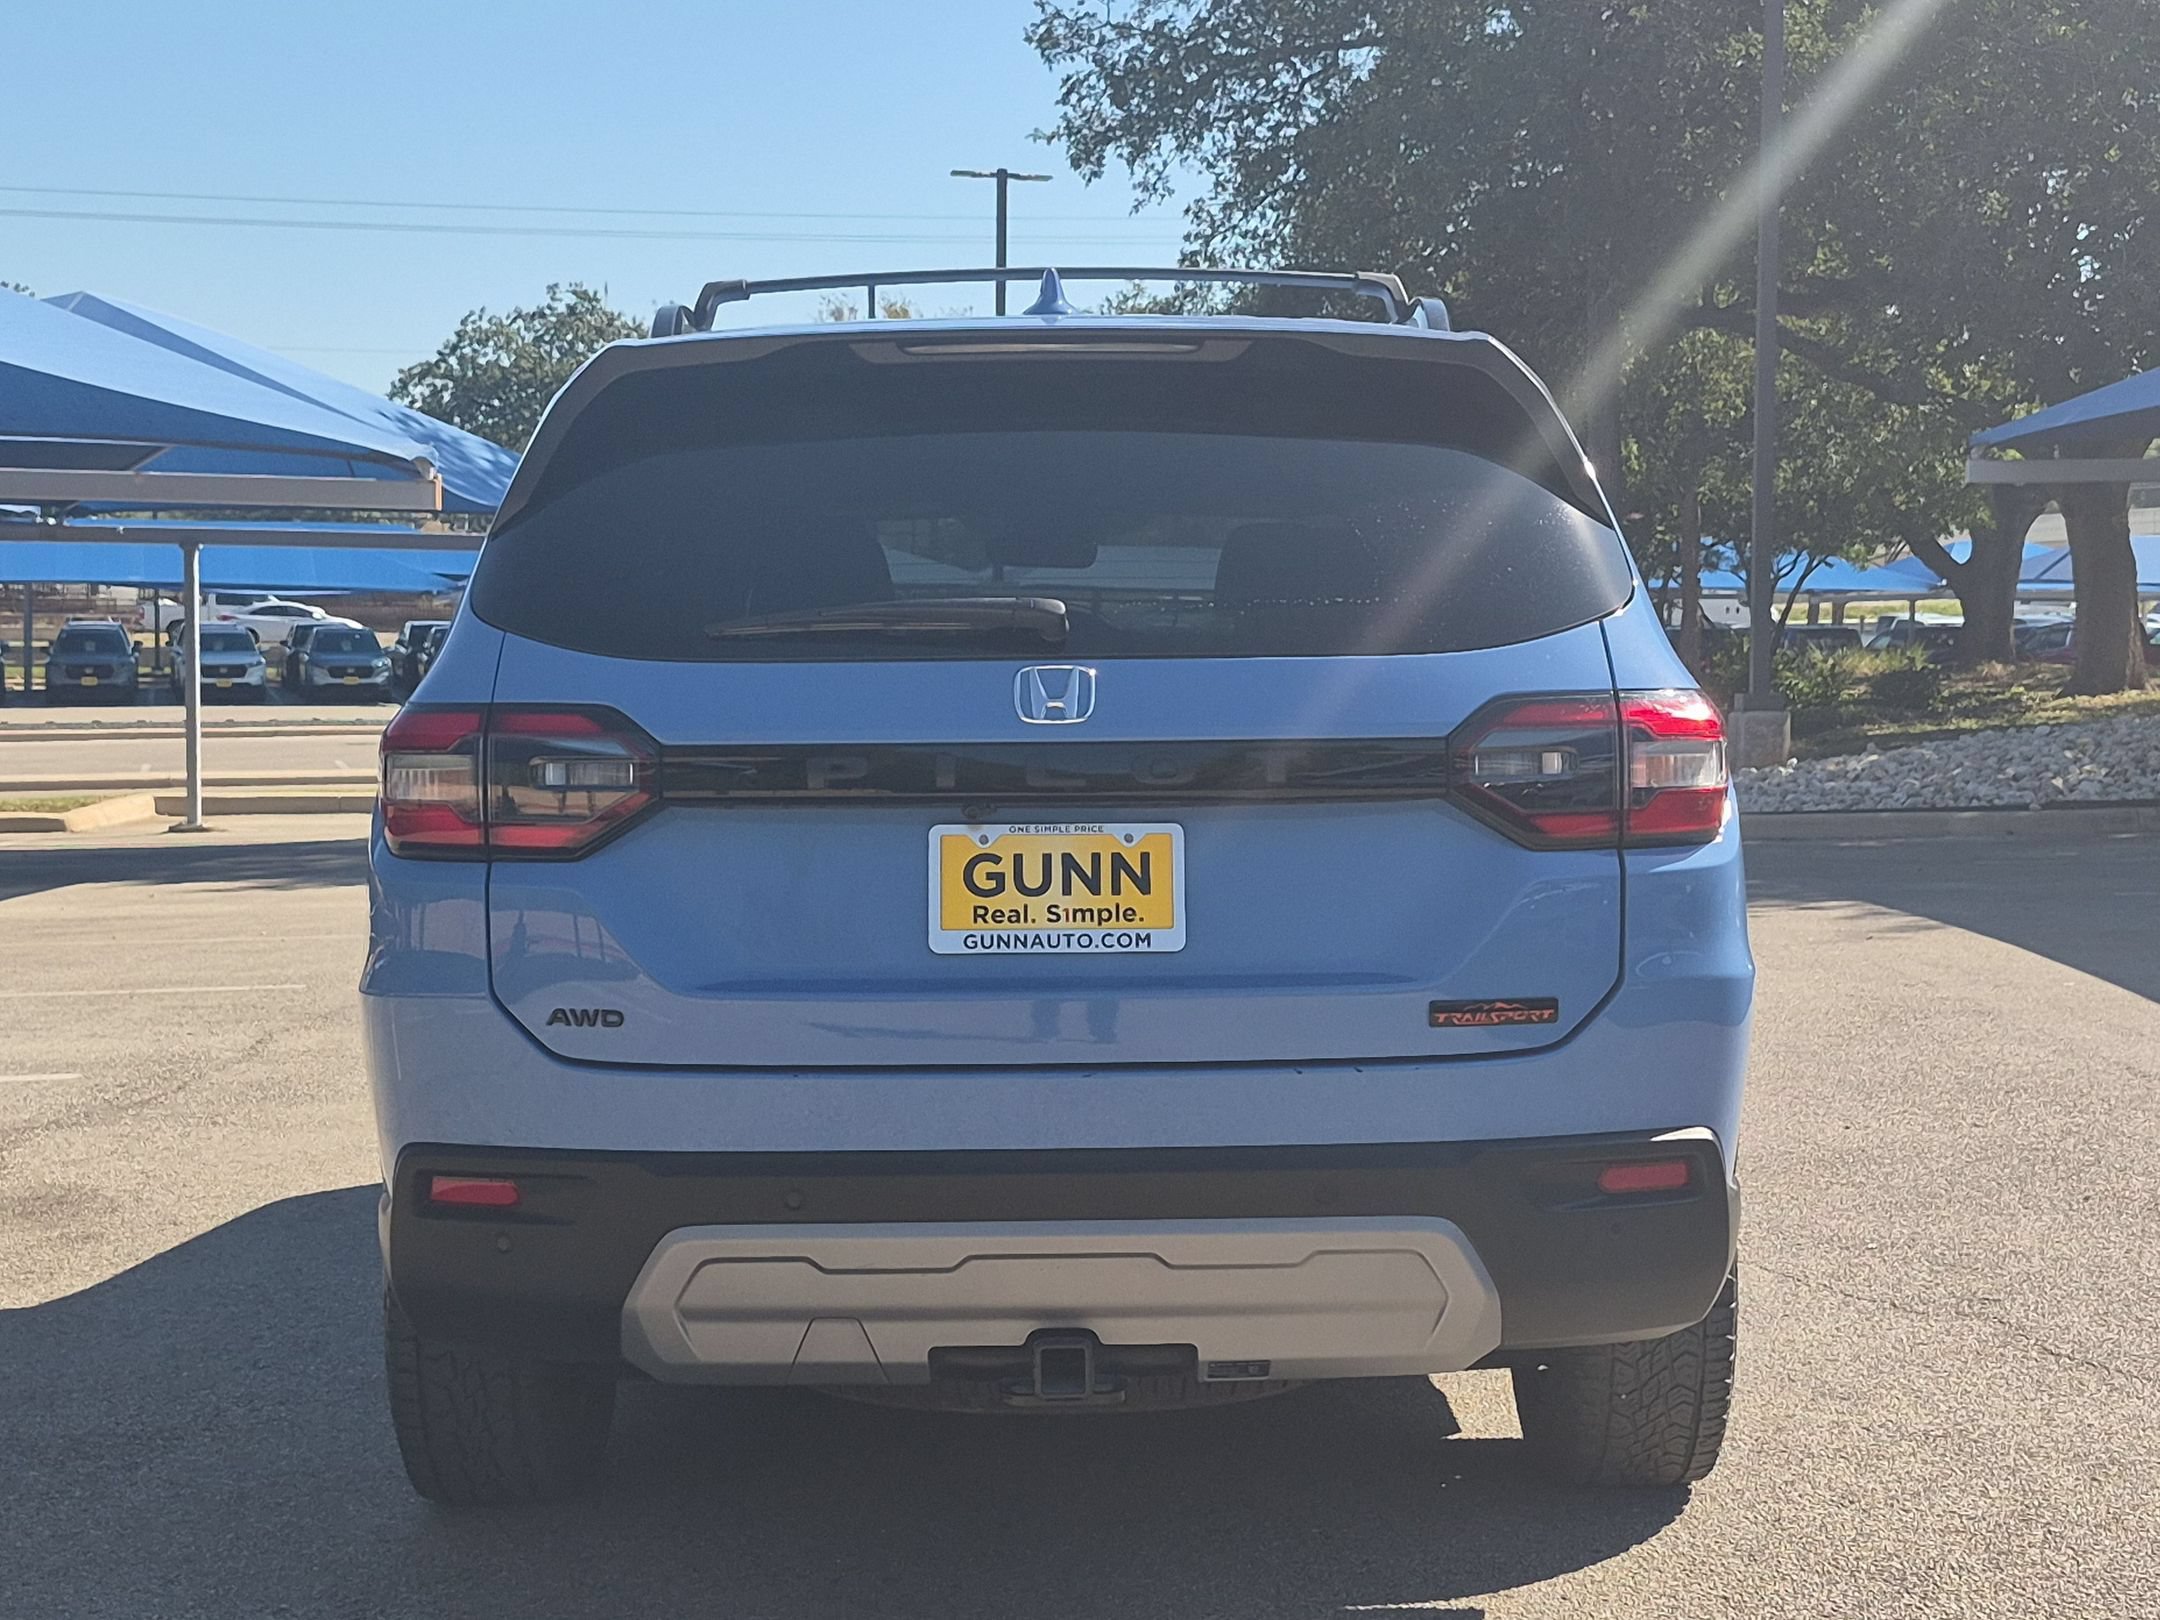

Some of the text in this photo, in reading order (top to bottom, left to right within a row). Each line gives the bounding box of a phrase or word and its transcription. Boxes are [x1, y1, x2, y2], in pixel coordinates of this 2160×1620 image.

[806, 750, 1308, 789] PILOT
[1009, 825, 1104, 833] ONE SIMPLE PRICE
[963, 851, 1151, 898] GUNN
[973, 904, 1036, 924] Real.
[963, 932, 1151, 950] GUNNAUTO.COM
[546, 1007, 625, 1028] AWD
[1434, 1009, 1554, 1025] TRAILSPORT
